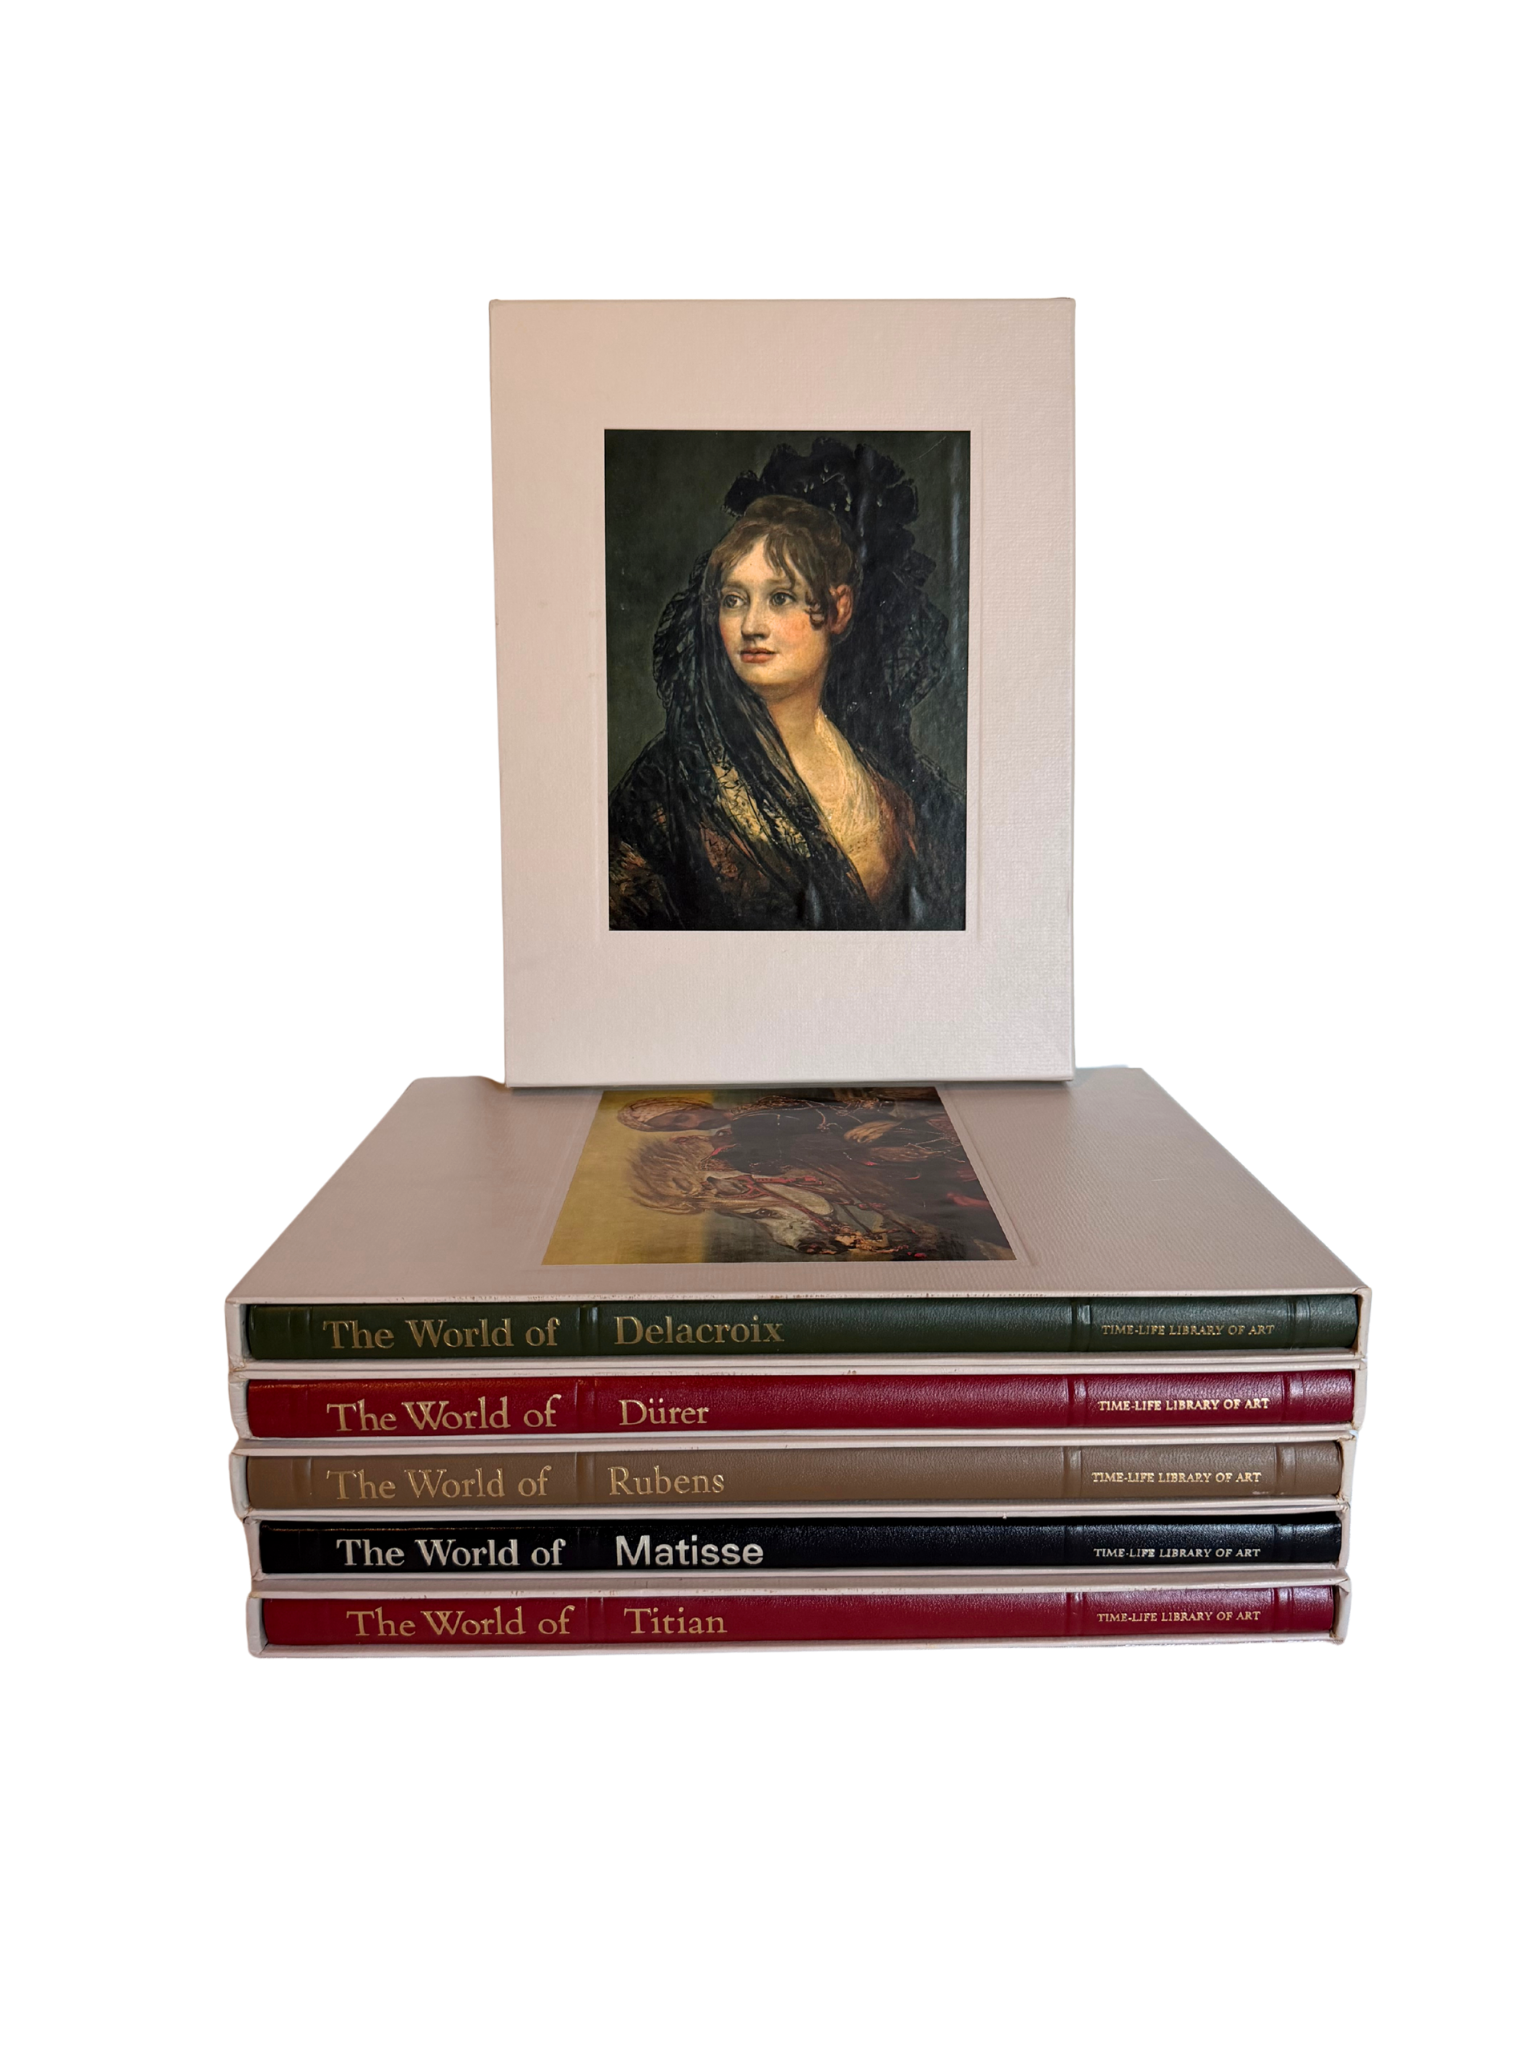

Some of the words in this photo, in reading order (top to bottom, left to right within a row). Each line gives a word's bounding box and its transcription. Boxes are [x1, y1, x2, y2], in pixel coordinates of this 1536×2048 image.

[323, 1318, 394, 1349] The
[406, 1318, 514, 1349] World
[525, 1317, 560, 1347] of
[614, 1315, 784, 1346] Delacroix
[1102, 1325, 1165, 1335] TIME-LIFE
[1169, 1325, 1223, 1335] LIBRARY
[1228, 1325, 1245, 1335] OF
[1248, 1325, 1275, 1335] ART
[327, 1400, 397, 1432] The
[402, 1397, 510, 1430] World
[524, 1394, 561, 1428] of
[618, 1396, 709, 1426] Dürer
[1098, 1400, 1163, 1411] TIME-LIFE
[1166, 1399, 1220, 1410] LIBRARY
[1223, 1399, 1241, 1410] OF
[1244, 1398, 1270, 1409] ART
[327, 1469, 396, 1500] The
[404, 1467, 505, 1499] World
[518, 1466, 552, 1497] of
[609, 1465, 725, 1496] Rubens
[1092, 1472, 1155, 1483] TIME-LIFE
[1158, 1472, 1212, 1483] LIBRARY
[1215, 1472, 1233, 1483] OF
[1236, 1472, 1262, 1483] ART
[336, 1539, 404, 1567] The
[415, 1539, 520, 1567] World
[531, 1539, 566, 1566] of
[616, 1535, 764, 1565] Matisse
[1094, 1548, 1155, 1558] TIME-LIFE
[1159, 1548, 1211, 1558] LIBRARY
[1216, 1548, 1232, 1558] OF
[1236, 1548, 1261, 1558] ART
[347, 1608, 416, 1638] The
[421, 1607, 526, 1637] World
[538, 1605, 574, 1635] of
[624, 1607, 728, 1635] Titian
[1097, 1613, 1157, 1623] TIME-LIFE
[1161, 1612, 1213, 1622] LIBRARY
[1217, 1612, 1233, 1621] OF
[1236, 1611, 1261, 1620] ART
